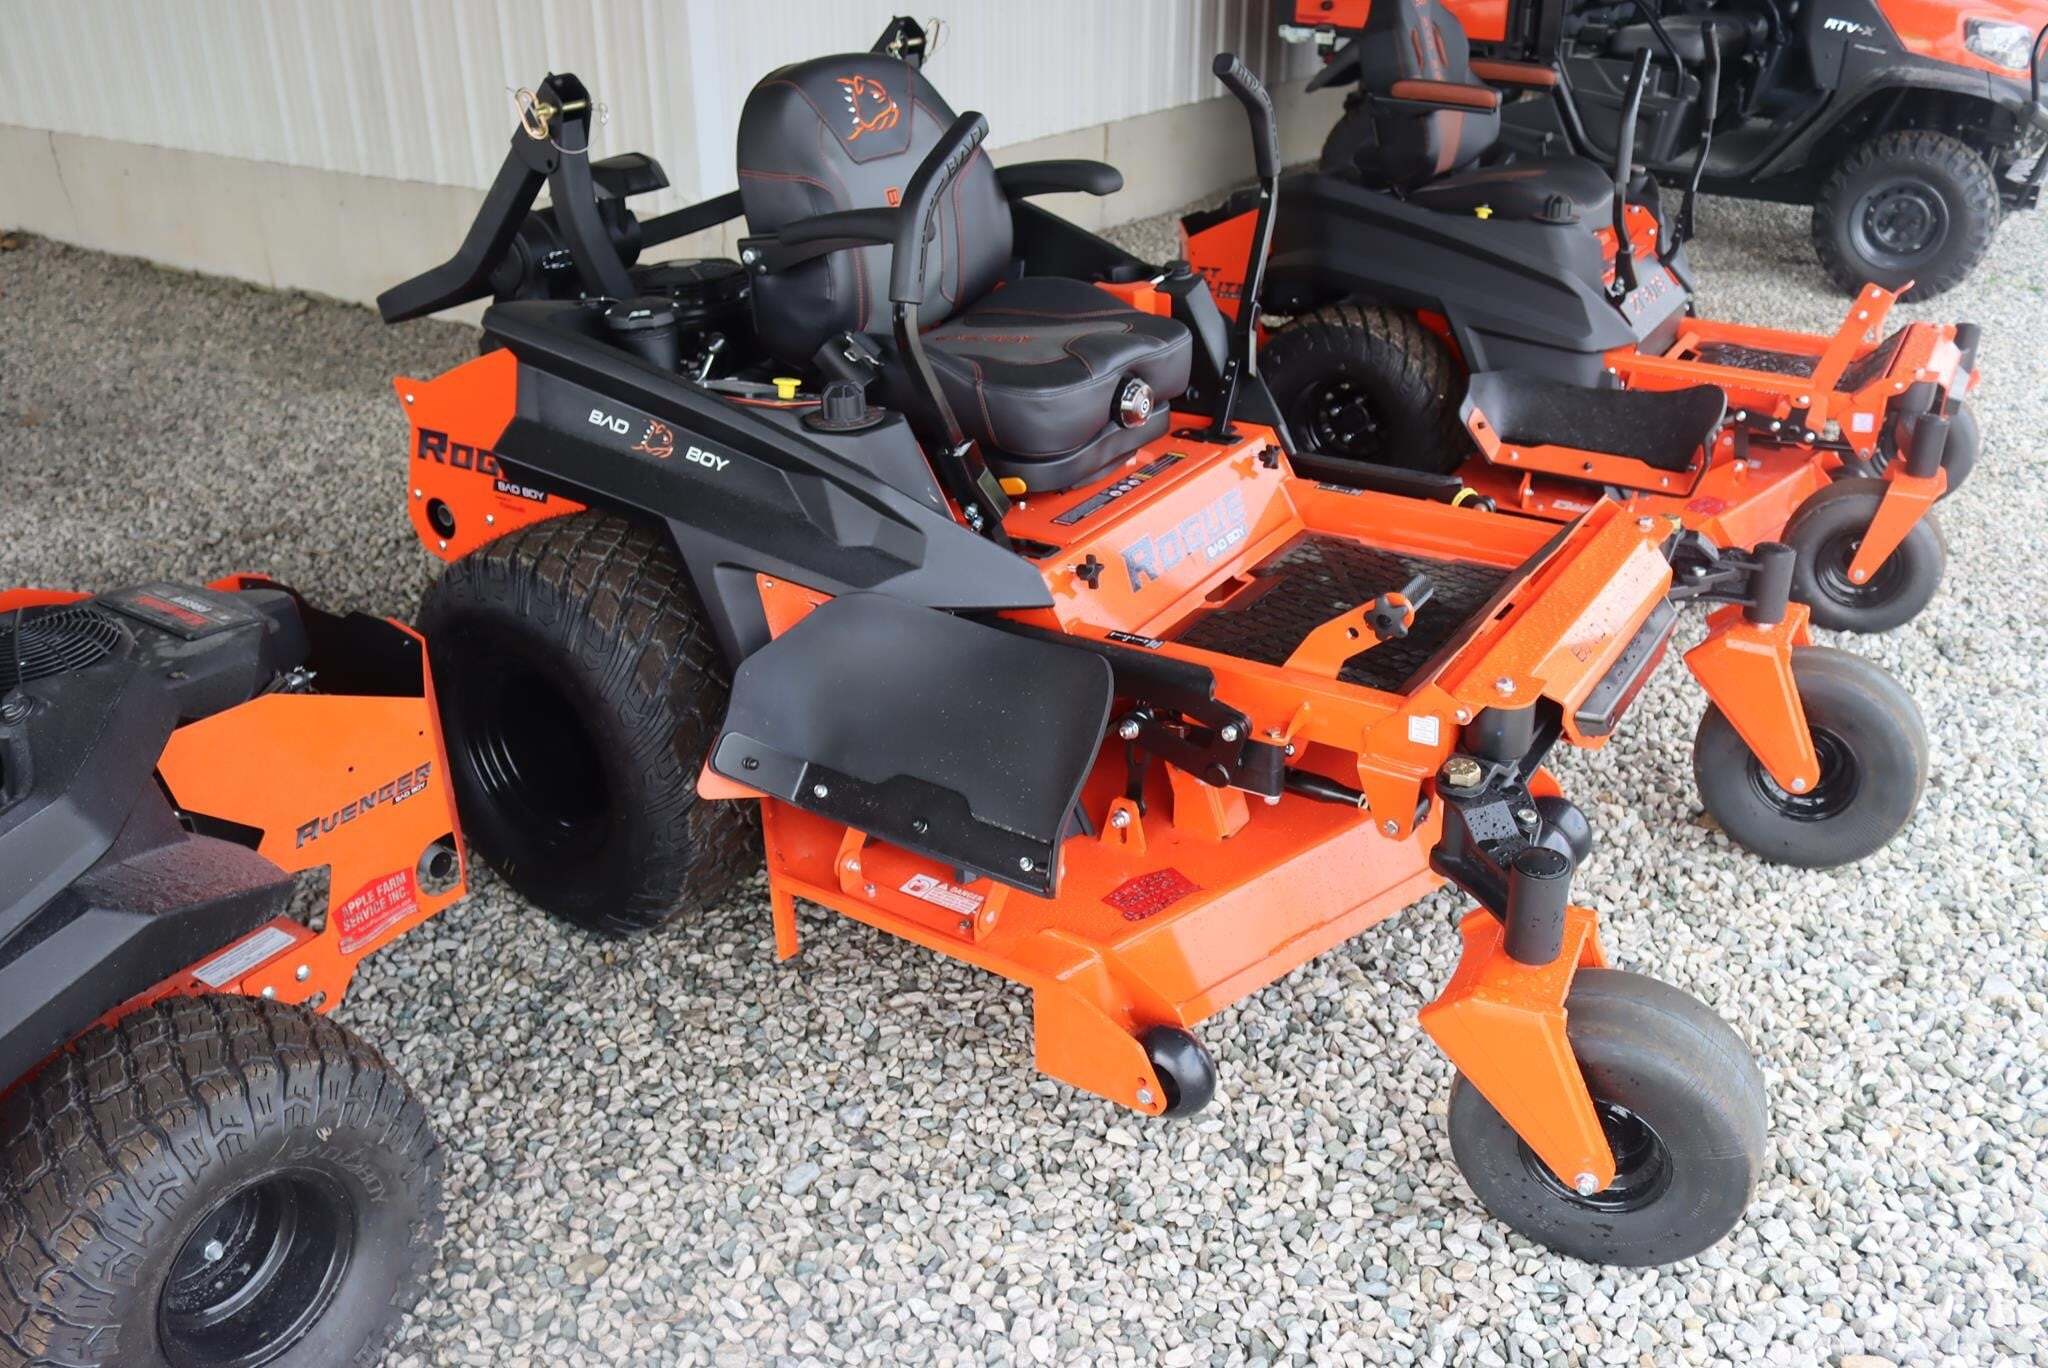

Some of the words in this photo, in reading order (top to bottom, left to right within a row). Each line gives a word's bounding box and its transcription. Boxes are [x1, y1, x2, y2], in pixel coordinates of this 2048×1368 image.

[1823, 17, 1876, 37] RTV-X
[417, 427, 500, 478] ROG
[588, 408, 630, 435] BAD
[685, 445, 731, 472] BOY
[497, 480, 521, 496] BAD
[522, 486, 545, 501] BOY
[1121, 487, 1248, 593] ROGUE
[1205, 538, 1227, 559] BAD
[1227, 526, 1246, 547] BOY
[295, 761, 432, 849] AVENGER
[342, 890, 375, 917] APPLE
[376, 871, 406, 898] FARM
[343, 897, 385, 932] SERVICE
